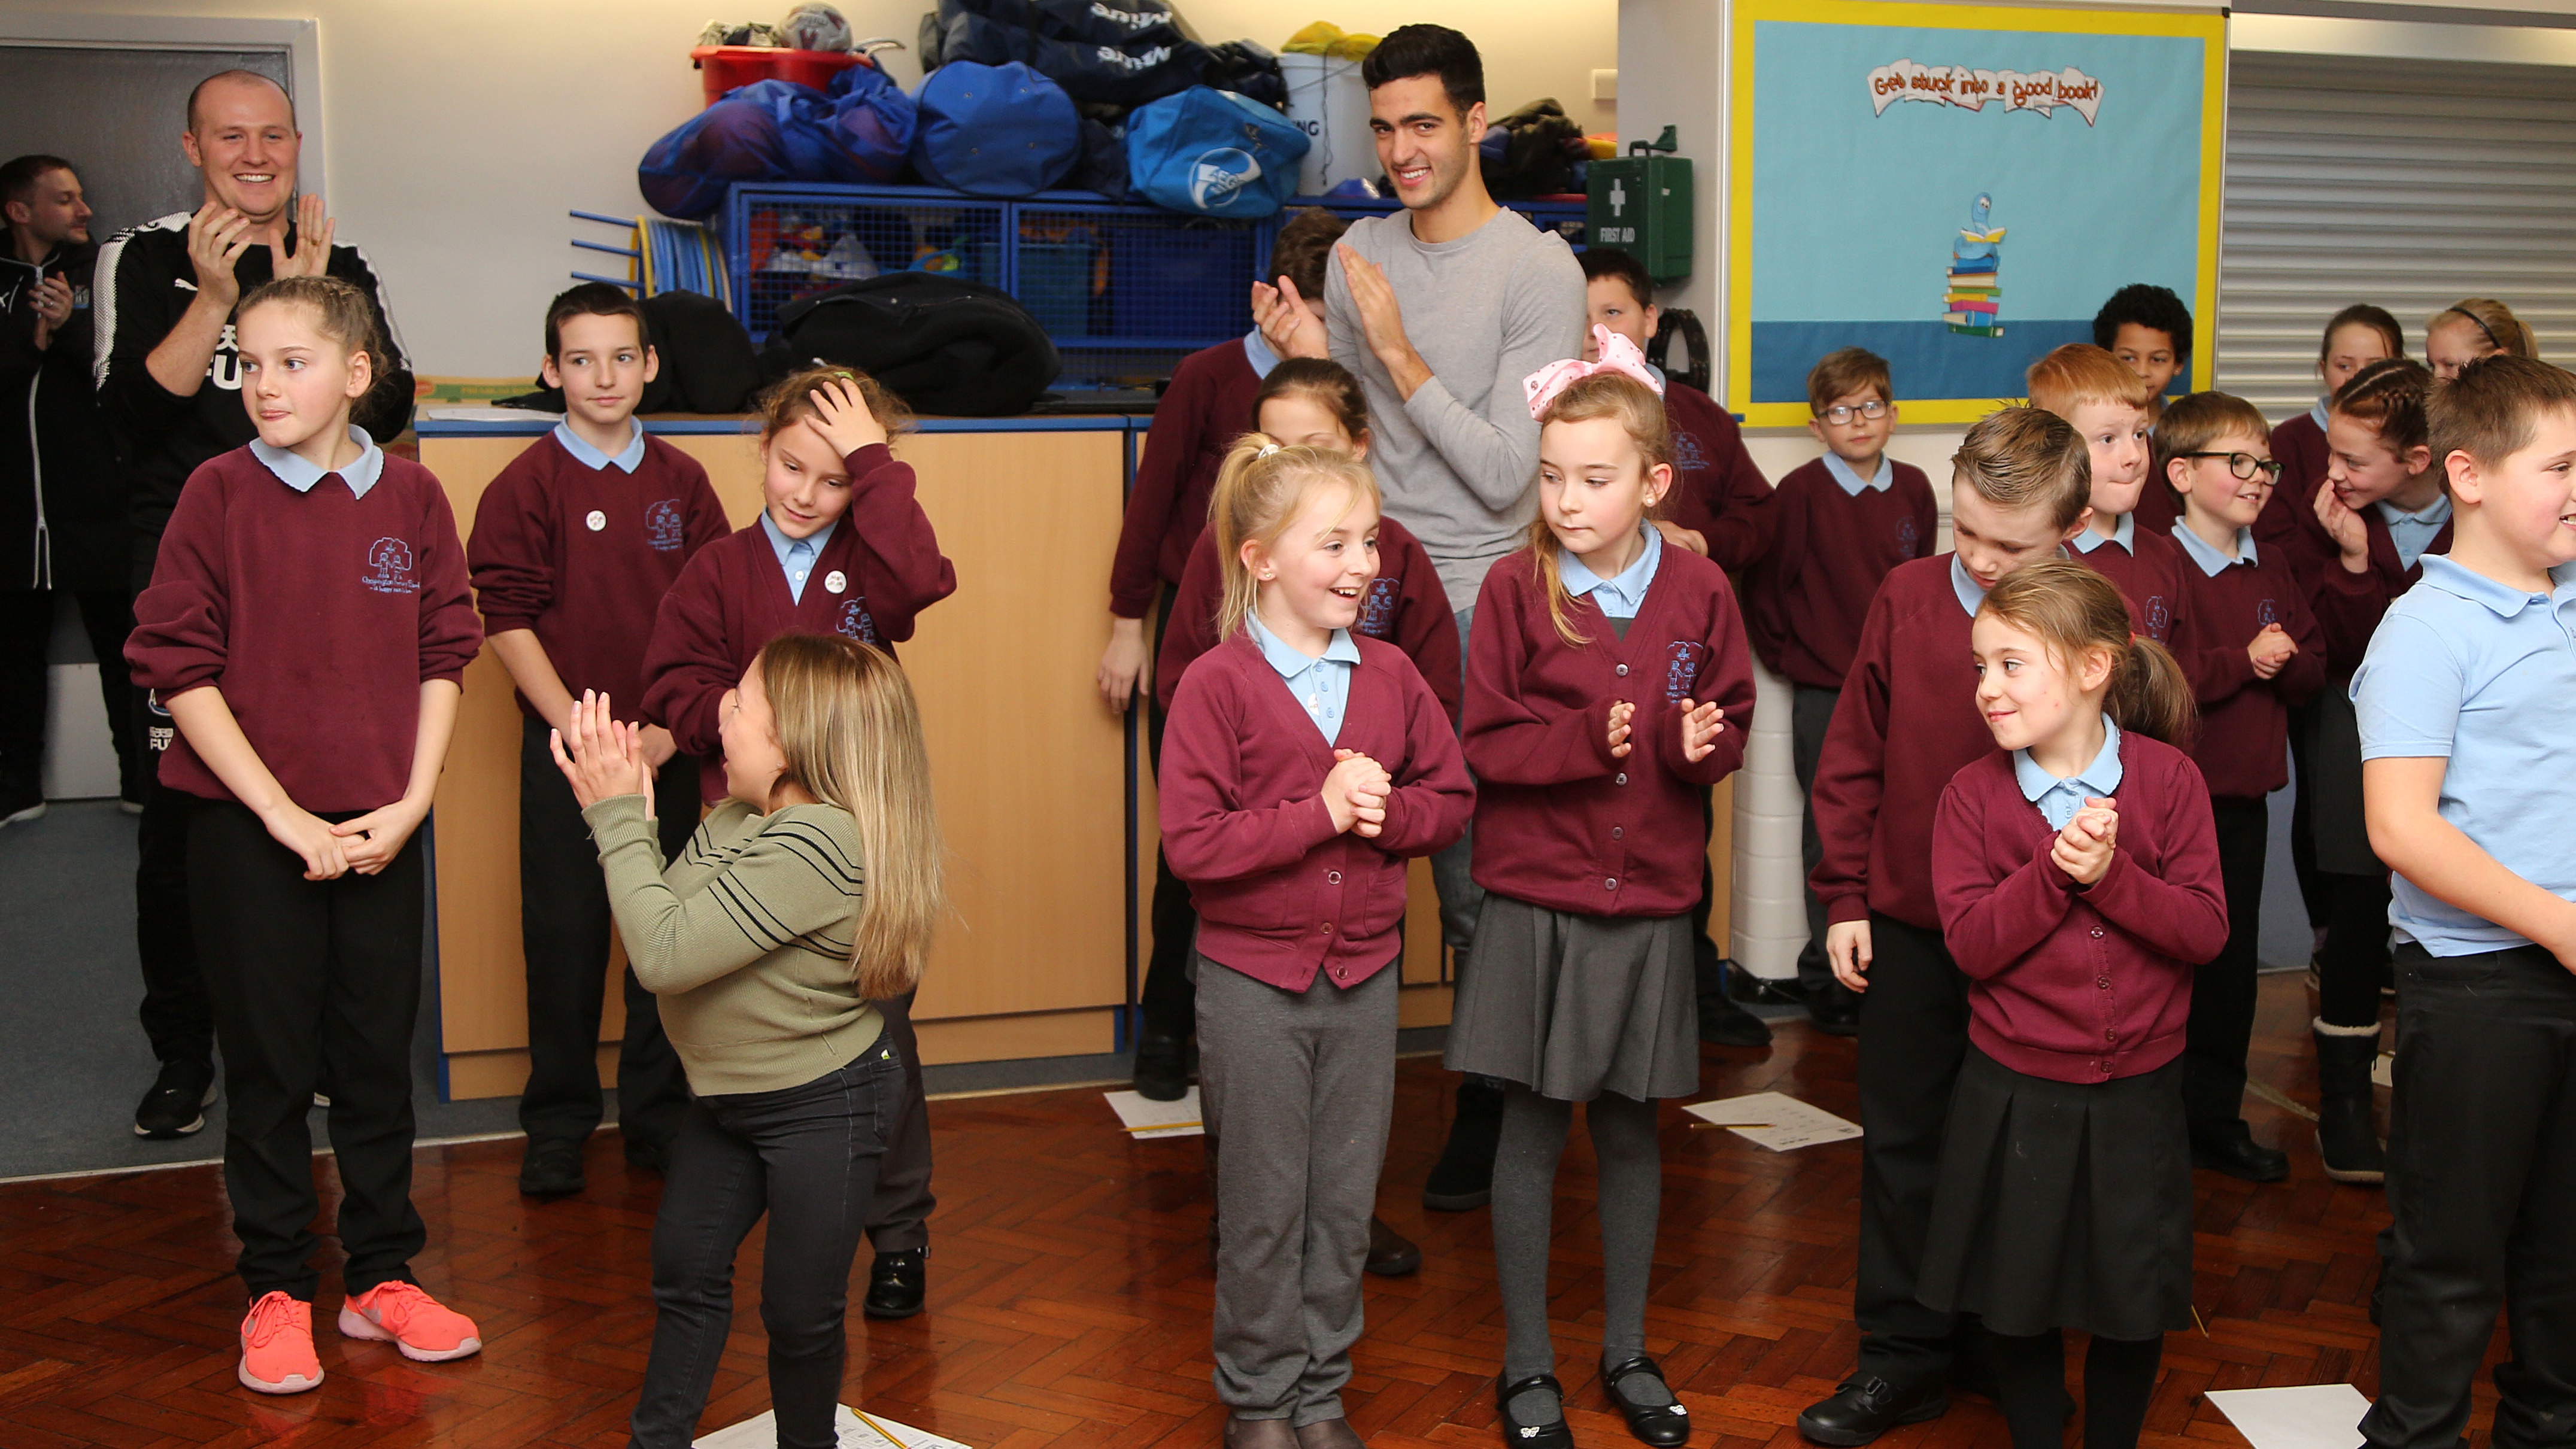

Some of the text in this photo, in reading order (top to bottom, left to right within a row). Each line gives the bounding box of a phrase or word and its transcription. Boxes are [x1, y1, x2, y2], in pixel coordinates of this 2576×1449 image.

[1875, 72, 2098, 107] Get stuck into a good book!
[1600, 227, 1635, 242] FIRST AID
